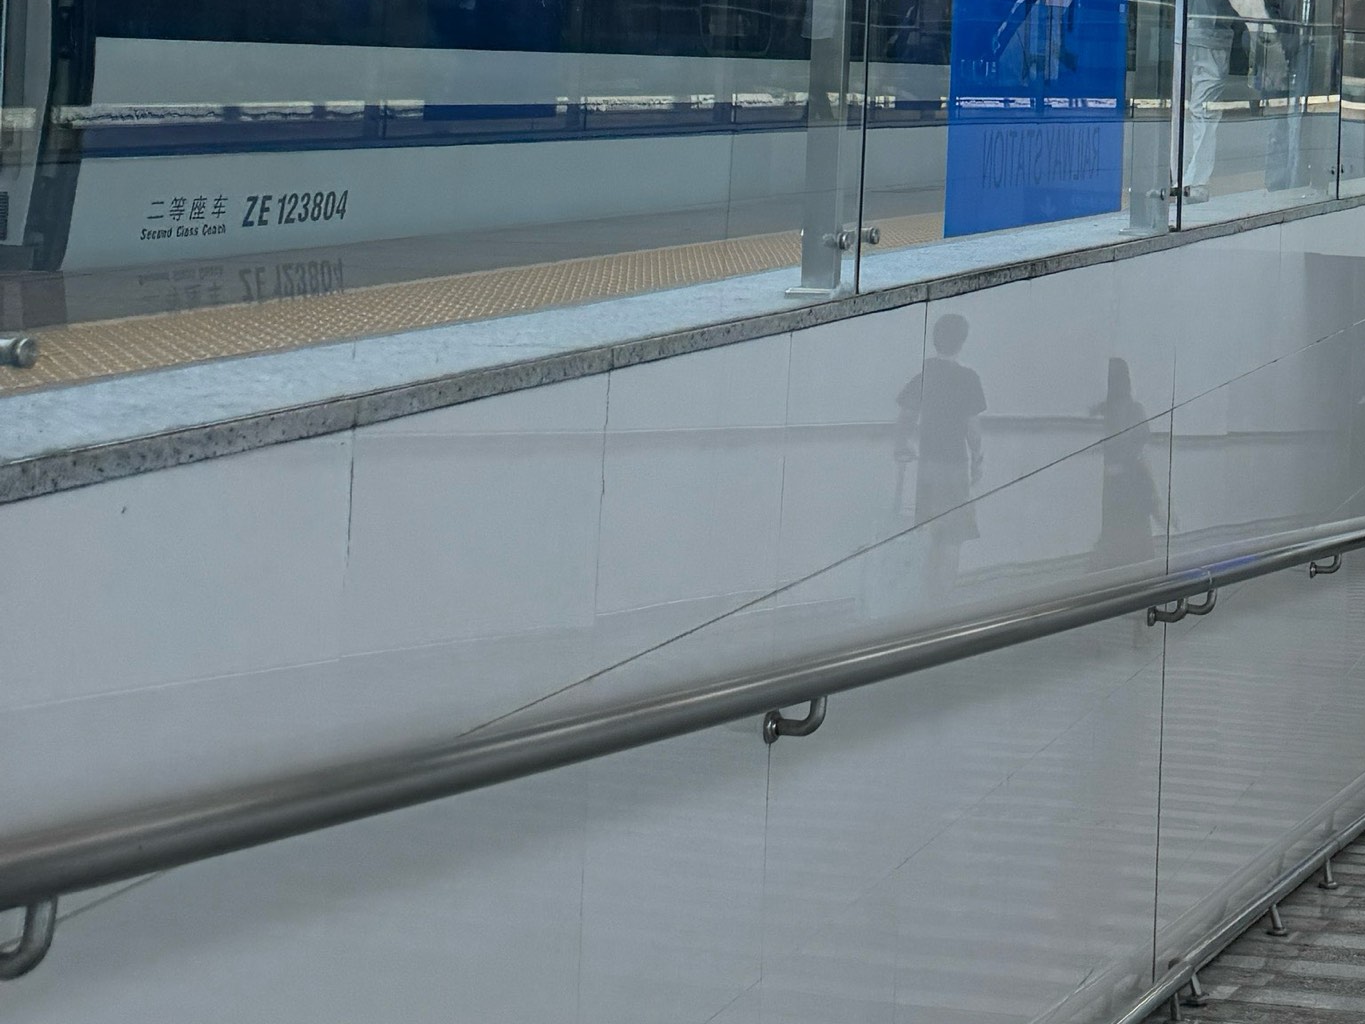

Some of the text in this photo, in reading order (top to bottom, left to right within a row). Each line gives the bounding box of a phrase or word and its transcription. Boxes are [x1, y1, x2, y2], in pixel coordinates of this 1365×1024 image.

[147, 194, 229, 222] 二等座车
[241, 189, 349, 228] ZE 123804
